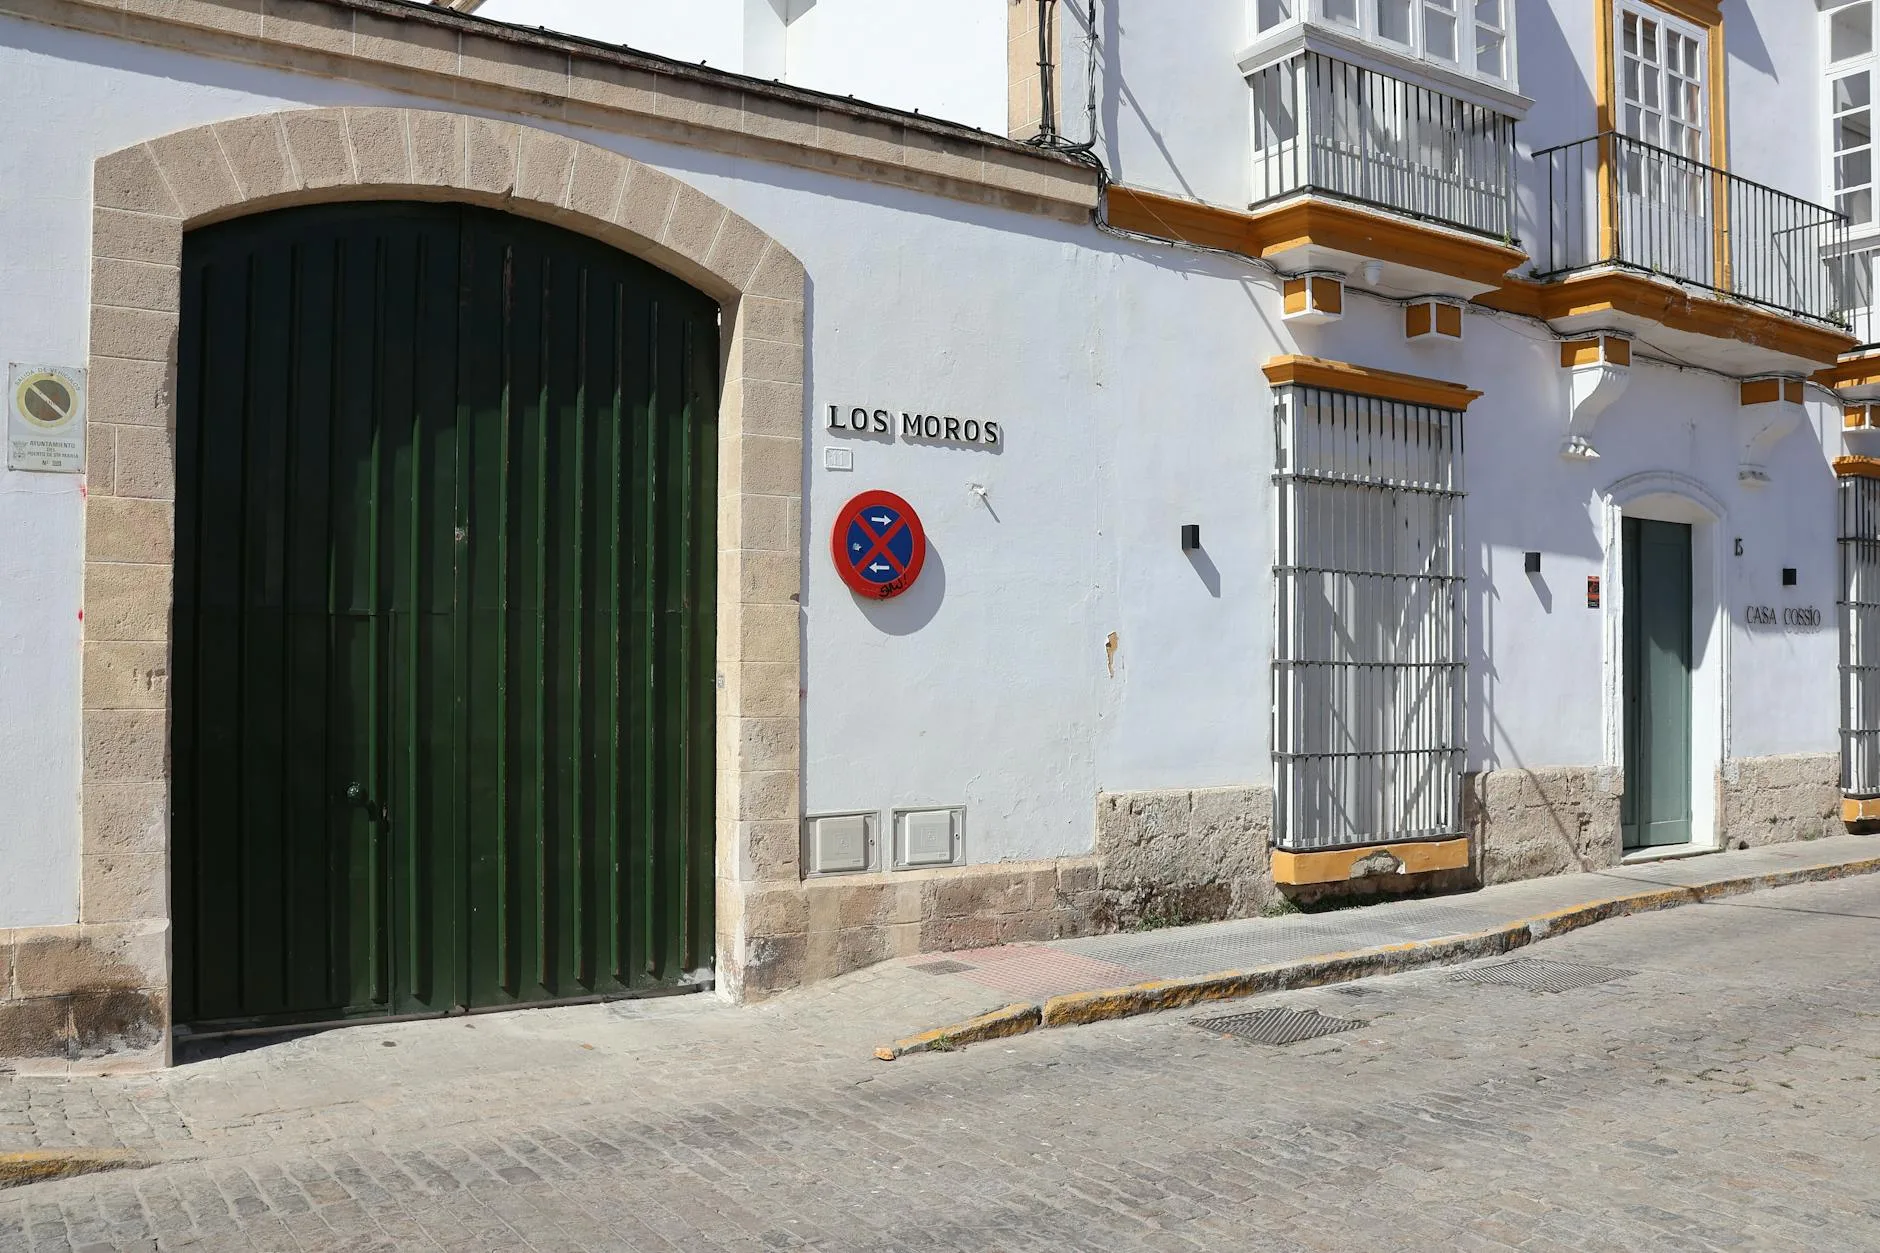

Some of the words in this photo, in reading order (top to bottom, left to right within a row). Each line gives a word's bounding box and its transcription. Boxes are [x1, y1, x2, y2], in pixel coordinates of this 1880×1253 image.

[828, 405, 888, 433] LOS
[901, 413, 999, 444] MOROS
[29, 440, 76, 448] AYUNTAMIENTO
[1734, 538, 1744, 556] 15
[1746, 605, 1777, 625] CASA
